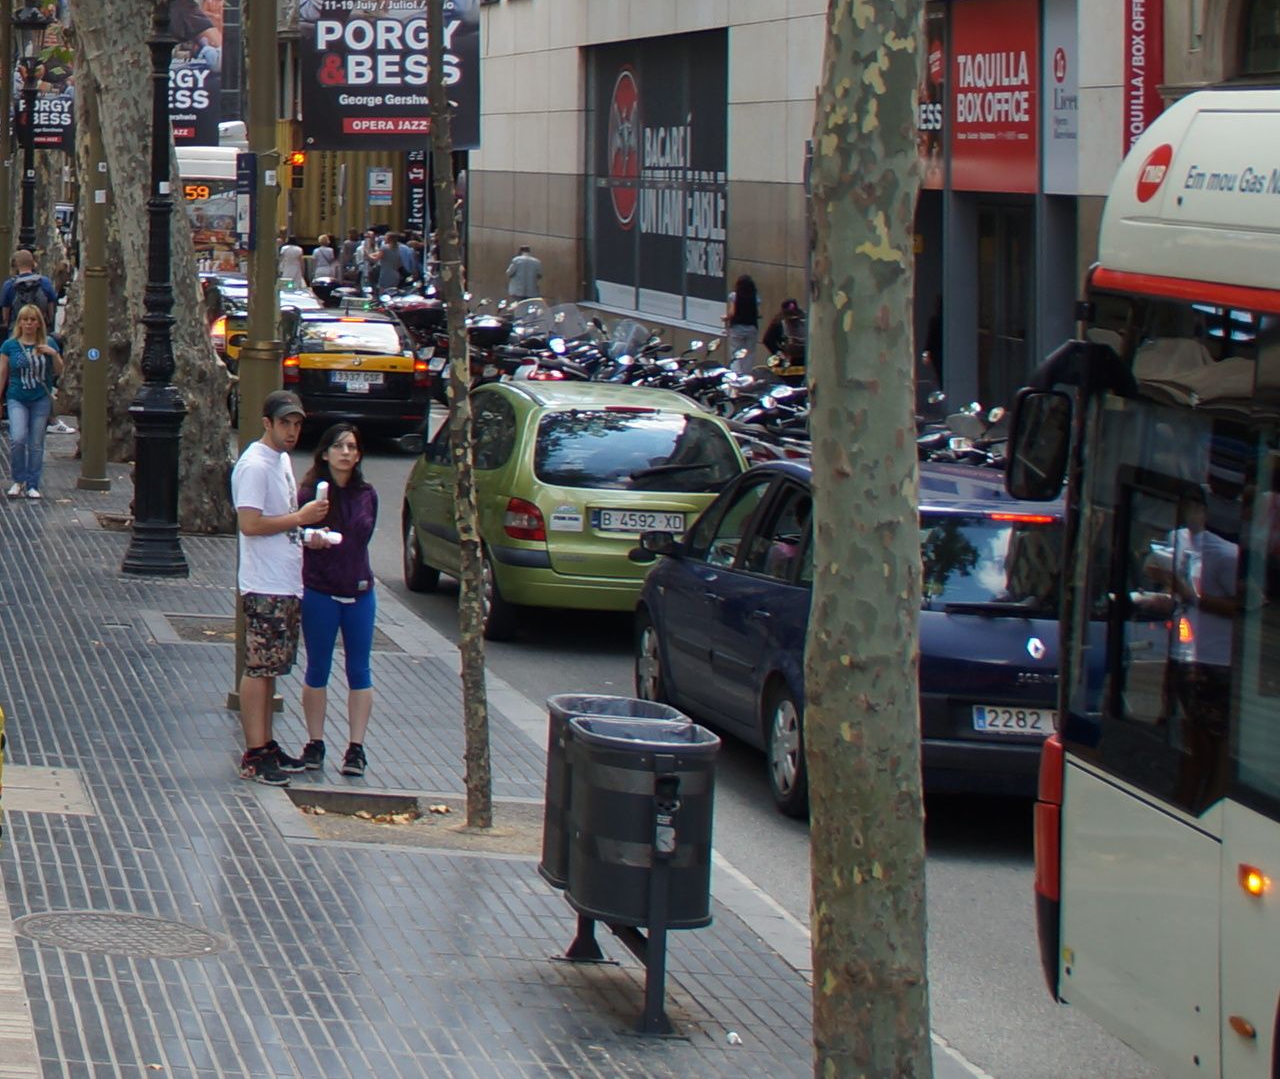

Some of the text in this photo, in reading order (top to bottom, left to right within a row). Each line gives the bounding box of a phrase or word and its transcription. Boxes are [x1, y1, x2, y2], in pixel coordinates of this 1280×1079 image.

[324, 0, 354, 10] 11-19
[356, 0, 377, 13] July
[317, 19, 462, 50] PORGY
[1132, 34, 1145, 67] BOX
[957, 51, 1029, 89] TAQUILLA
[339, 94, 429, 107] George Gershw
[957, 91, 1029, 122] BOX OFFICE
[352, 120, 428, 130] OPERA JAZZ
[919, 103, 942, 130] ESS
[1184, 165, 1207, 189] Em
[1239, 166, 1266, 193] Gas
[185, 186, 210, 201] 59
[987, 709, 1041, 730] 2282
